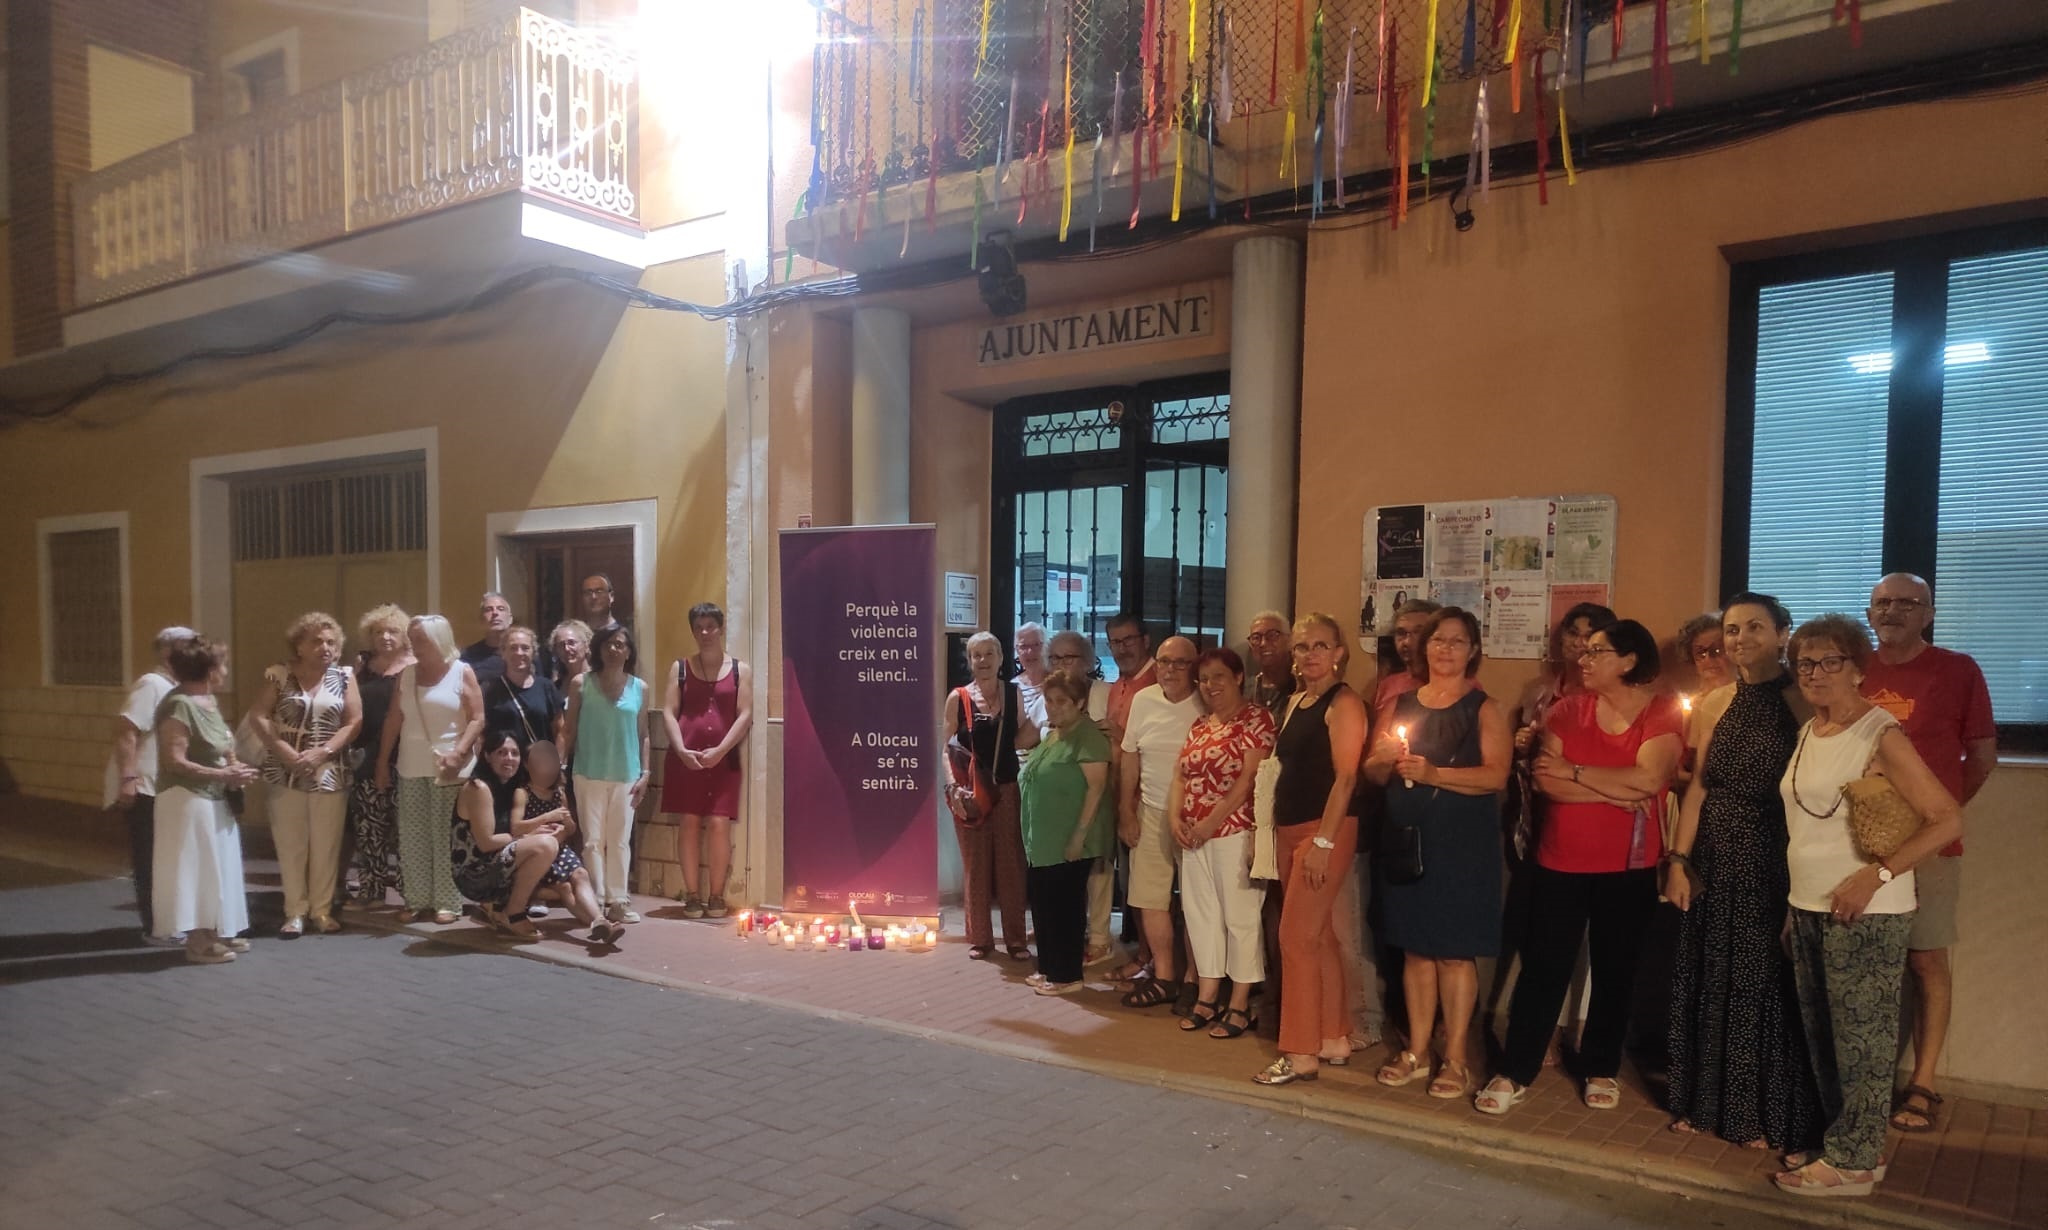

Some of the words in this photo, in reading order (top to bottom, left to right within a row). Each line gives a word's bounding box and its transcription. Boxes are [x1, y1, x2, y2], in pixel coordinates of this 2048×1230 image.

[979, 296, 1208, 362] AJUNTAMENT
[846, 601, 898, 620] Perquè
[904, 602, 917, 616] la
[851, 623, 917, 639] violència
[839, 646, 875, 661] creix
[880, 649, 899, 661] en
[904, 645, 917, 660] el
[858, 667, 918, 682] silenci...
[851, 732, 862, 747] A
[867, 733, 918, 747] Olocau
[862, 774, 918, 790] sentirà.
